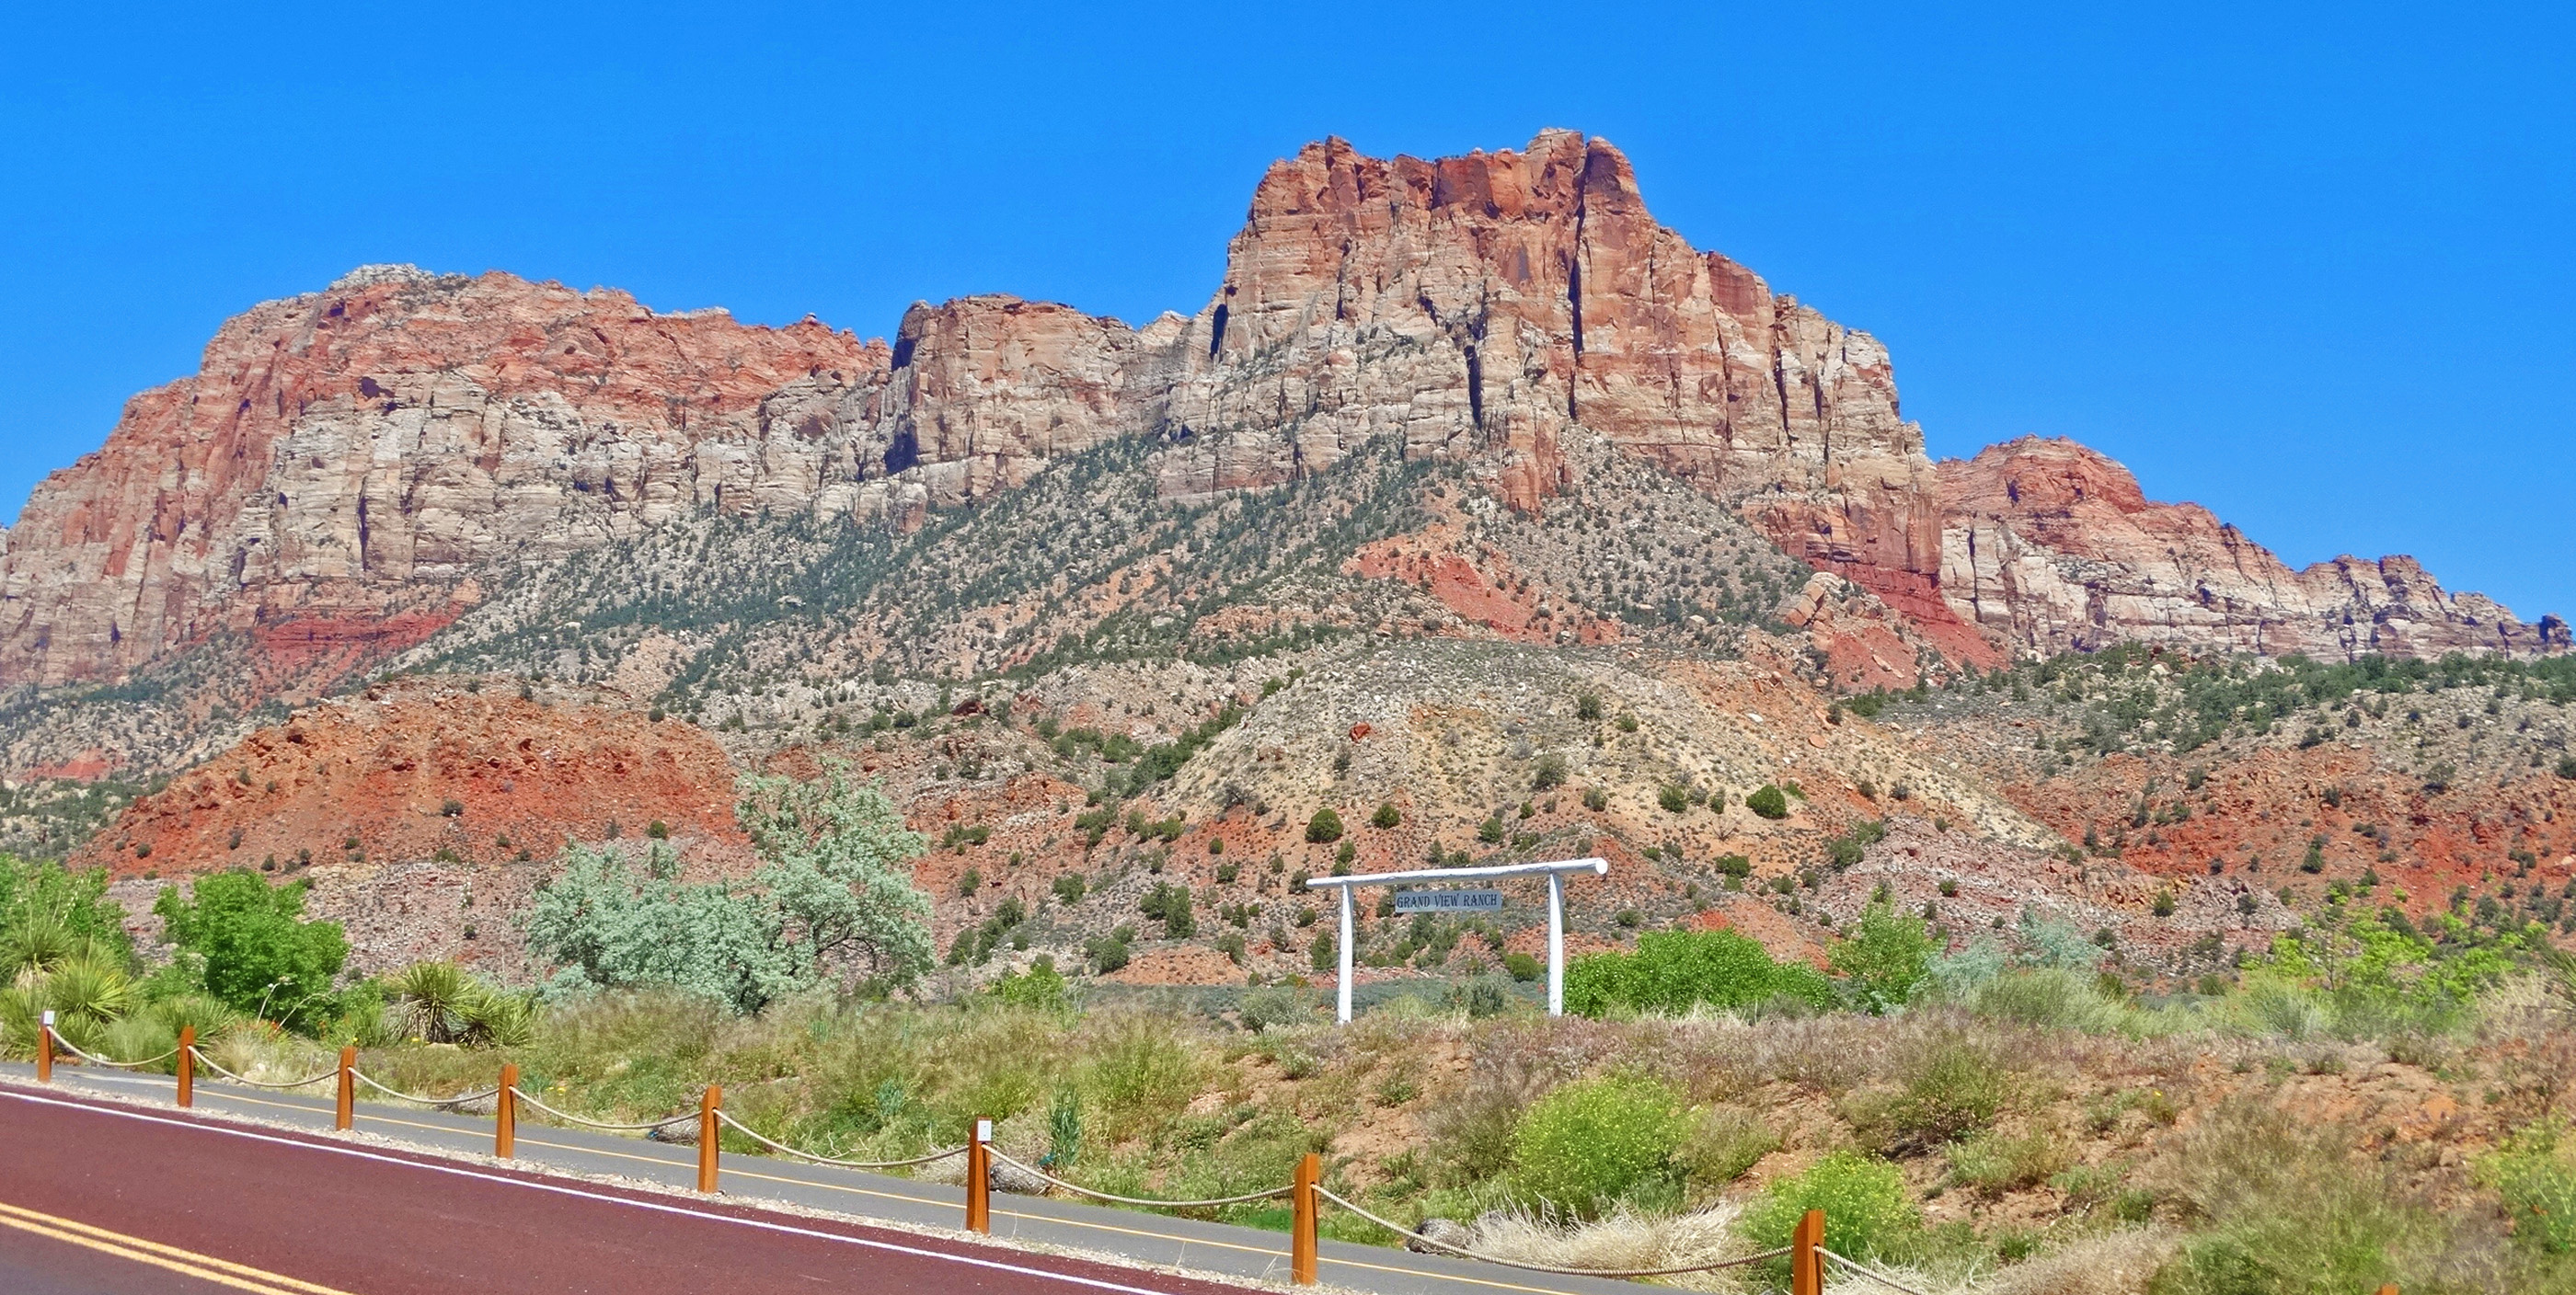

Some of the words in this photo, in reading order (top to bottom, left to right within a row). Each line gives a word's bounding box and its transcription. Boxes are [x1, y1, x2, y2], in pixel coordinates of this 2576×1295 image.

[1397, 895, 1431, 908] GRAND
[1434, 893, 1459, 907] VIEW
[1463, 893, 1498, 907] RANCH
